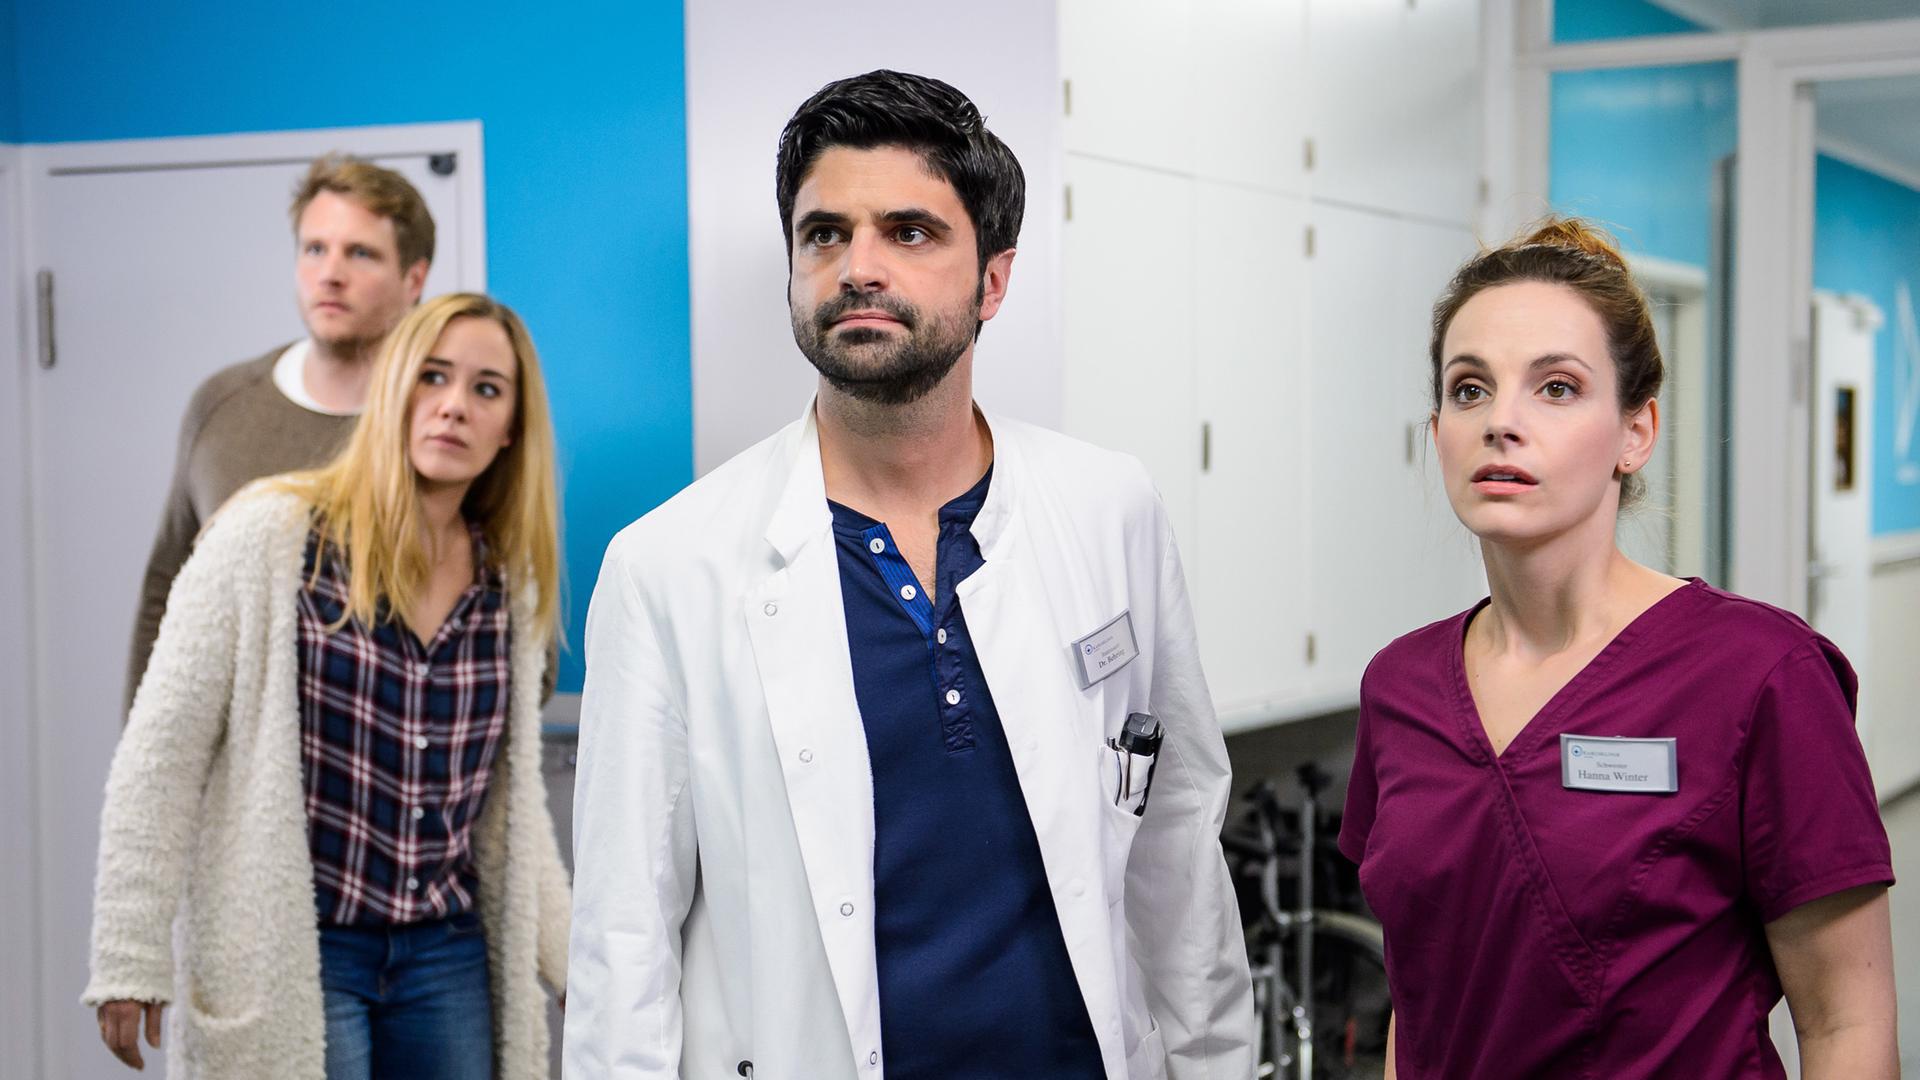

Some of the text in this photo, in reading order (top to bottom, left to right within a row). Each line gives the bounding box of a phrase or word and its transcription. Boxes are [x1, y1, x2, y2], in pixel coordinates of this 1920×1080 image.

[1098, 660, 1108, 669] Dr.
[1578, 769, 1648, 782] Hanna Winter
